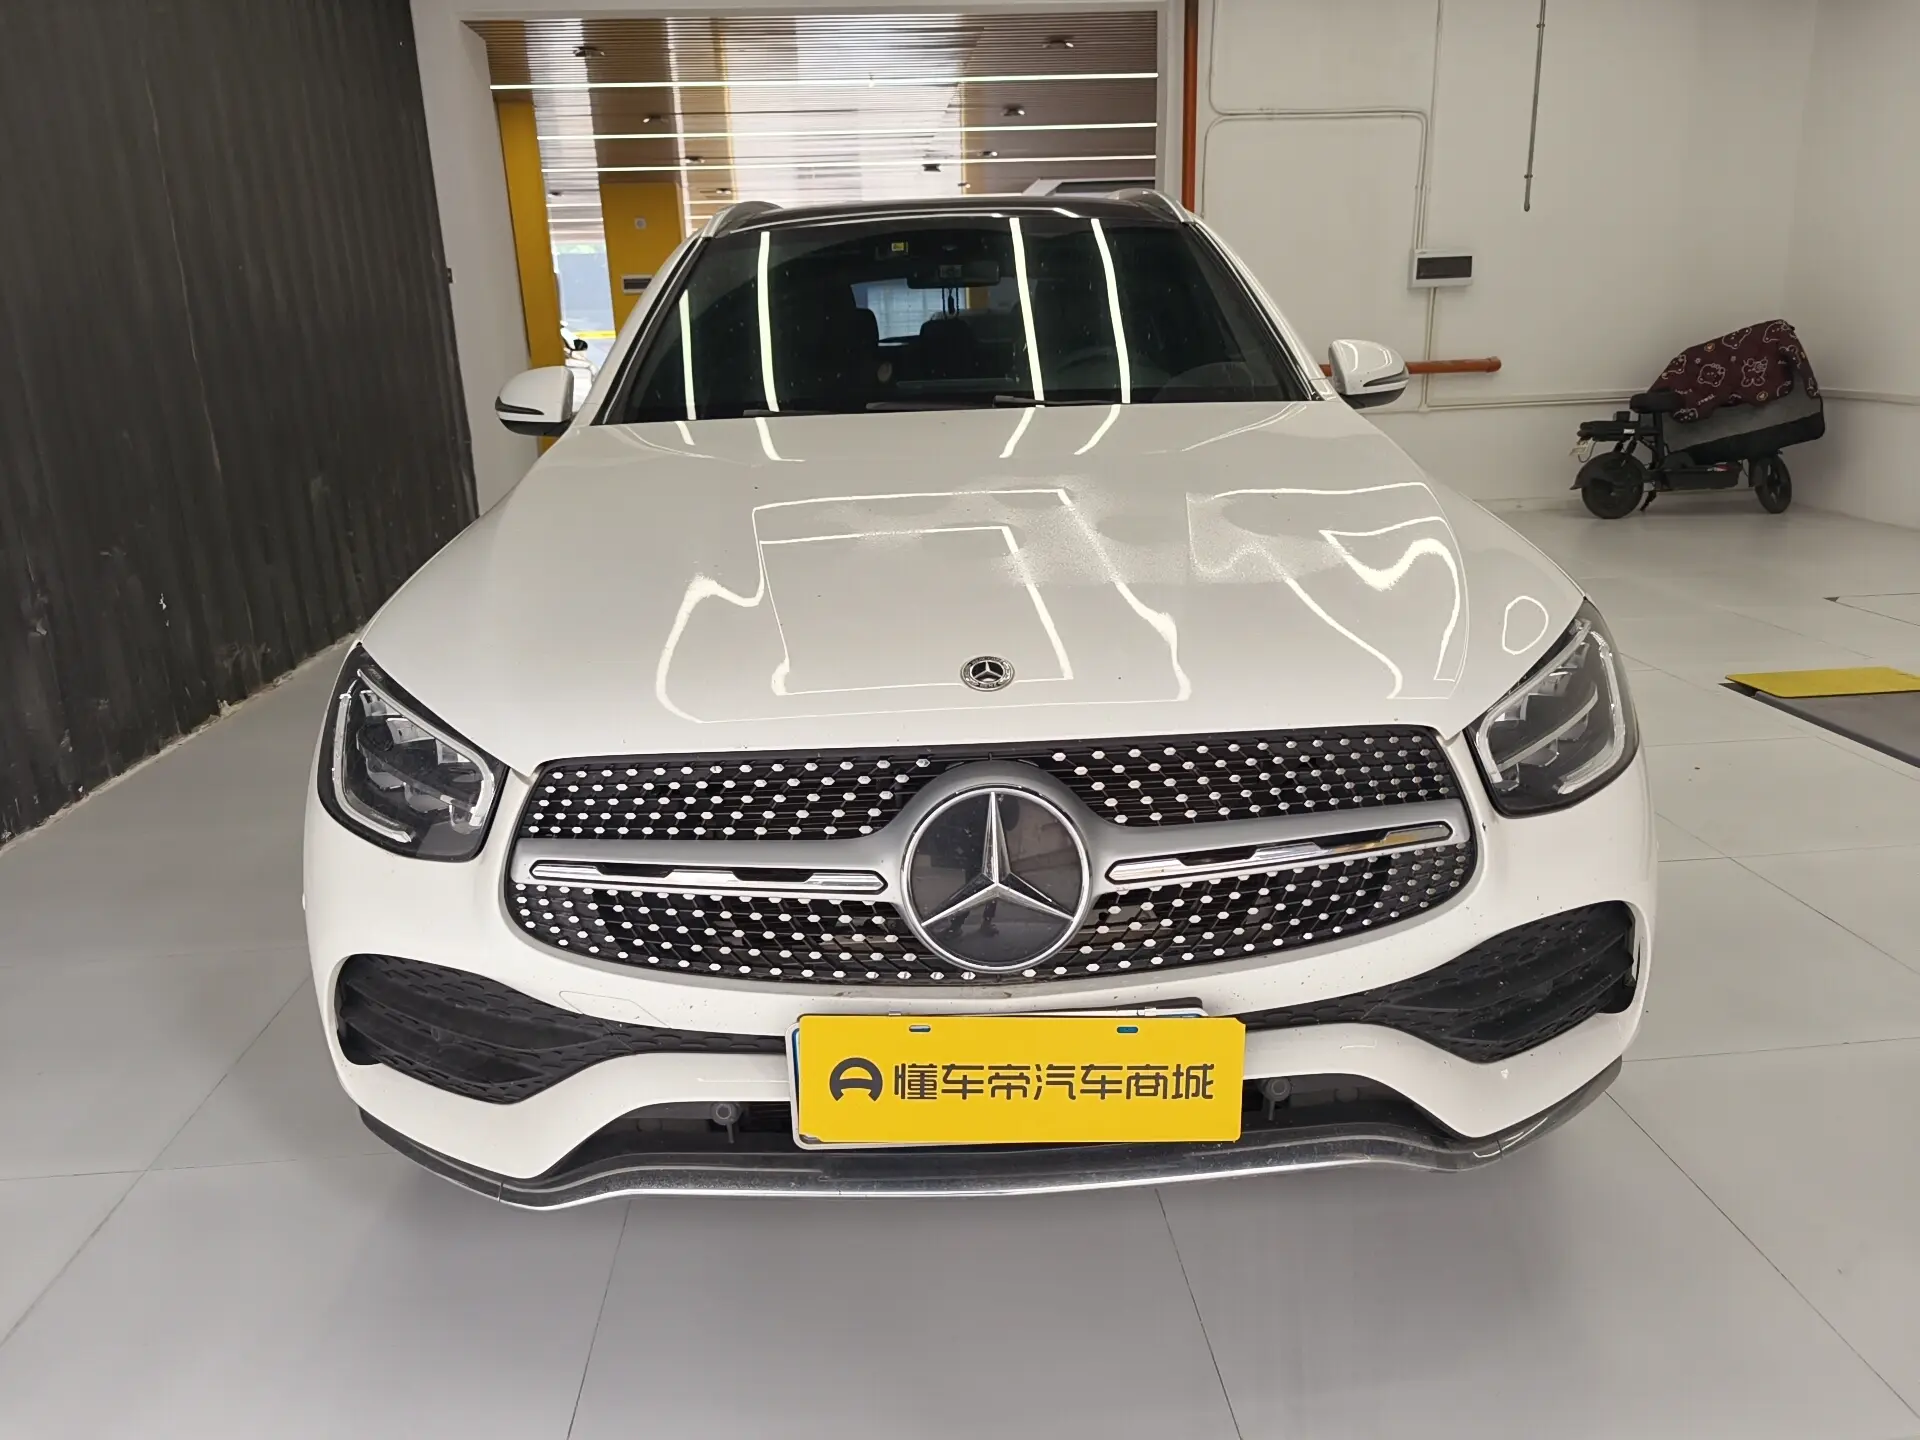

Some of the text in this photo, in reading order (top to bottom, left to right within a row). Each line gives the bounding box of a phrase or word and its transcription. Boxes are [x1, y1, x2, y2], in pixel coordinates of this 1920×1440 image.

[893, 1062, 1215, 1101] 懂车帝汽车商城
